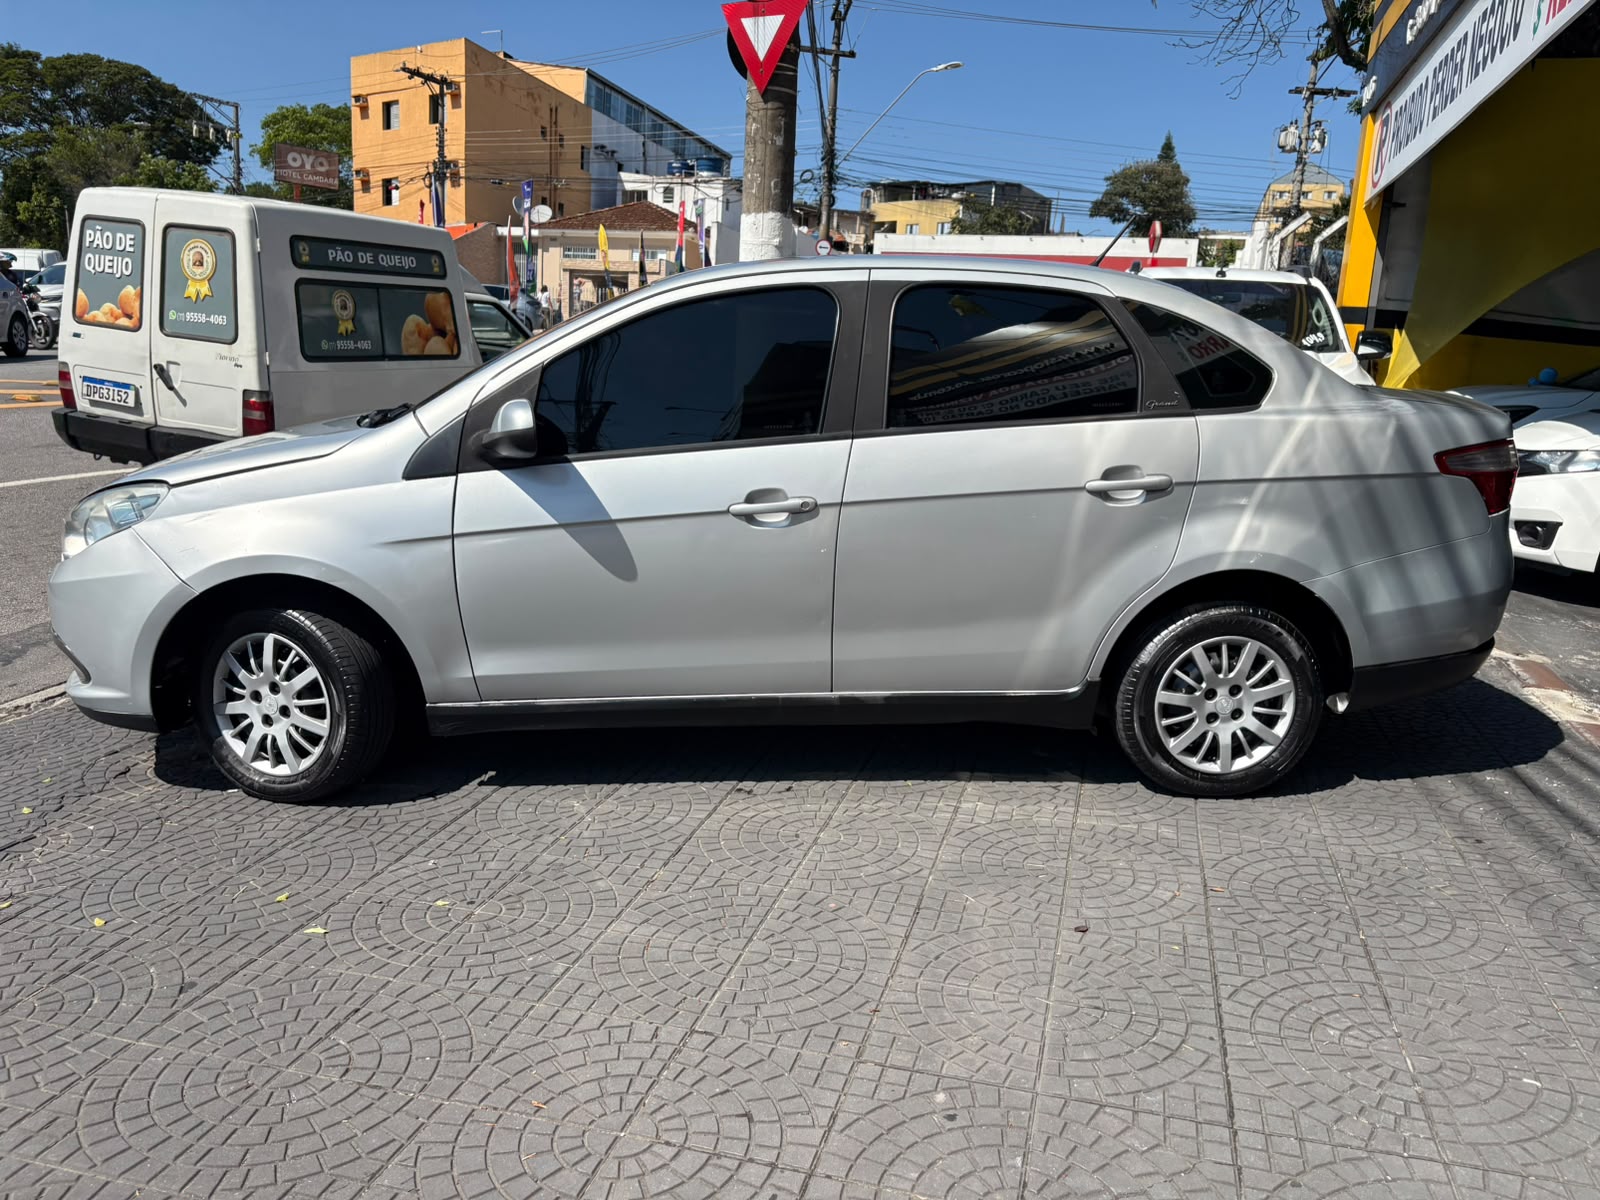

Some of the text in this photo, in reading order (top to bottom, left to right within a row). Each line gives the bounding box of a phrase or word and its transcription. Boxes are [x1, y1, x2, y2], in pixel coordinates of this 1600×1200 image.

[1389, 75, 1429, 164] PROIBIDO
[1426, 30, 1469, 128] PERDER
[287, 151, 330, 172] OYO
[86, 224, 135, 252] PÃO DE
[85, 253, 133, 278] QUEIJO
[328, 247, 416, 269] PÃO DE QUEIJO
[186, 312, 227, 325] 95558-4063
